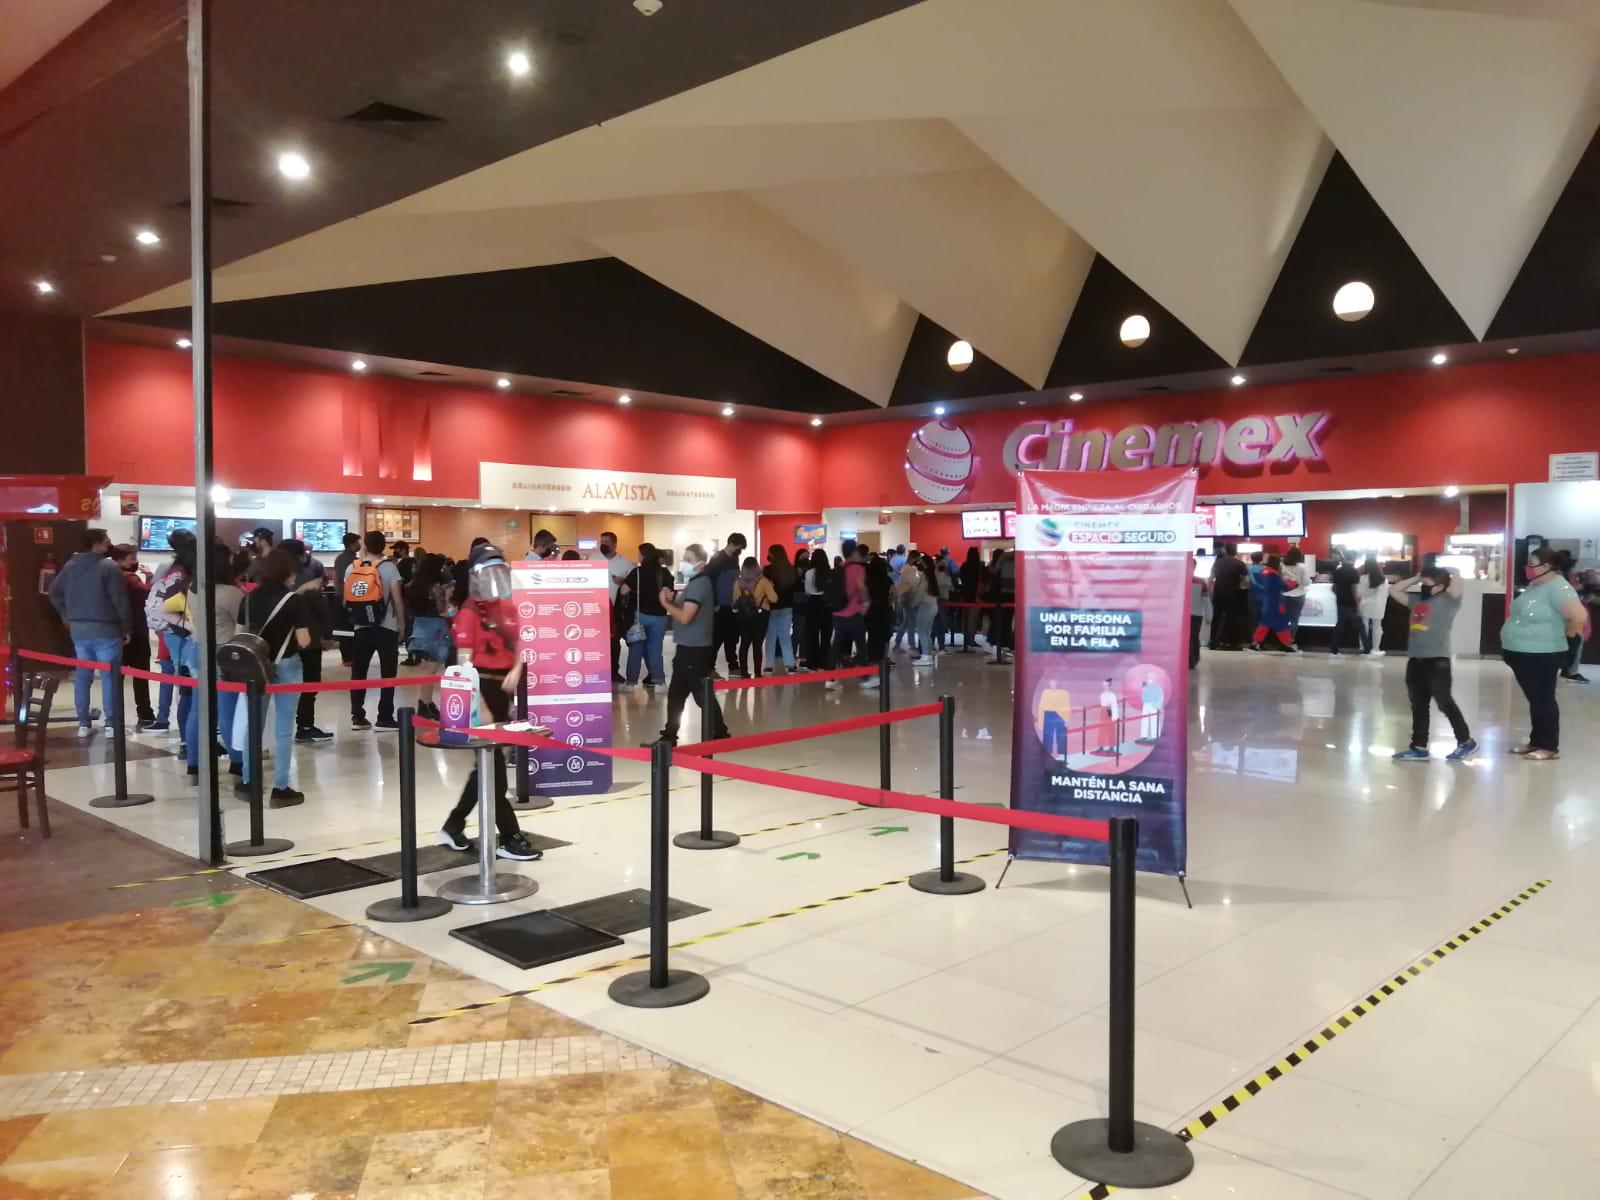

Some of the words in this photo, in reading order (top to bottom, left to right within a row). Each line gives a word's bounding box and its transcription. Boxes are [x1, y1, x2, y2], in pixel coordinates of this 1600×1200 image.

[582, 482, 657, 501] ALAVISTA
[1027, 503, 1039, 511] LA
[1072, 531, 1122, 543] ESPACIO
[1124, 531, 1175, 543] SEGURO
[1039, 612, 1068, 623] UNA
[1070, 614, 1132, 624] PERSONA
[1044, 625, 1071, 634] POR
[1074, 625, 1126, 636] FAMILIA
[1050, 636, 1068, 646] EN
[1070, 637, 1087, 646] LA
[1090, 638, 1120, 648] FILA
[1051, 775, 1106, 789] MANTÉN
[1108, 780, 1126, 790] LA
[1129, 781, 1166, 793] SANA
[1073, 789, 1143, 803] DISTANCIA
